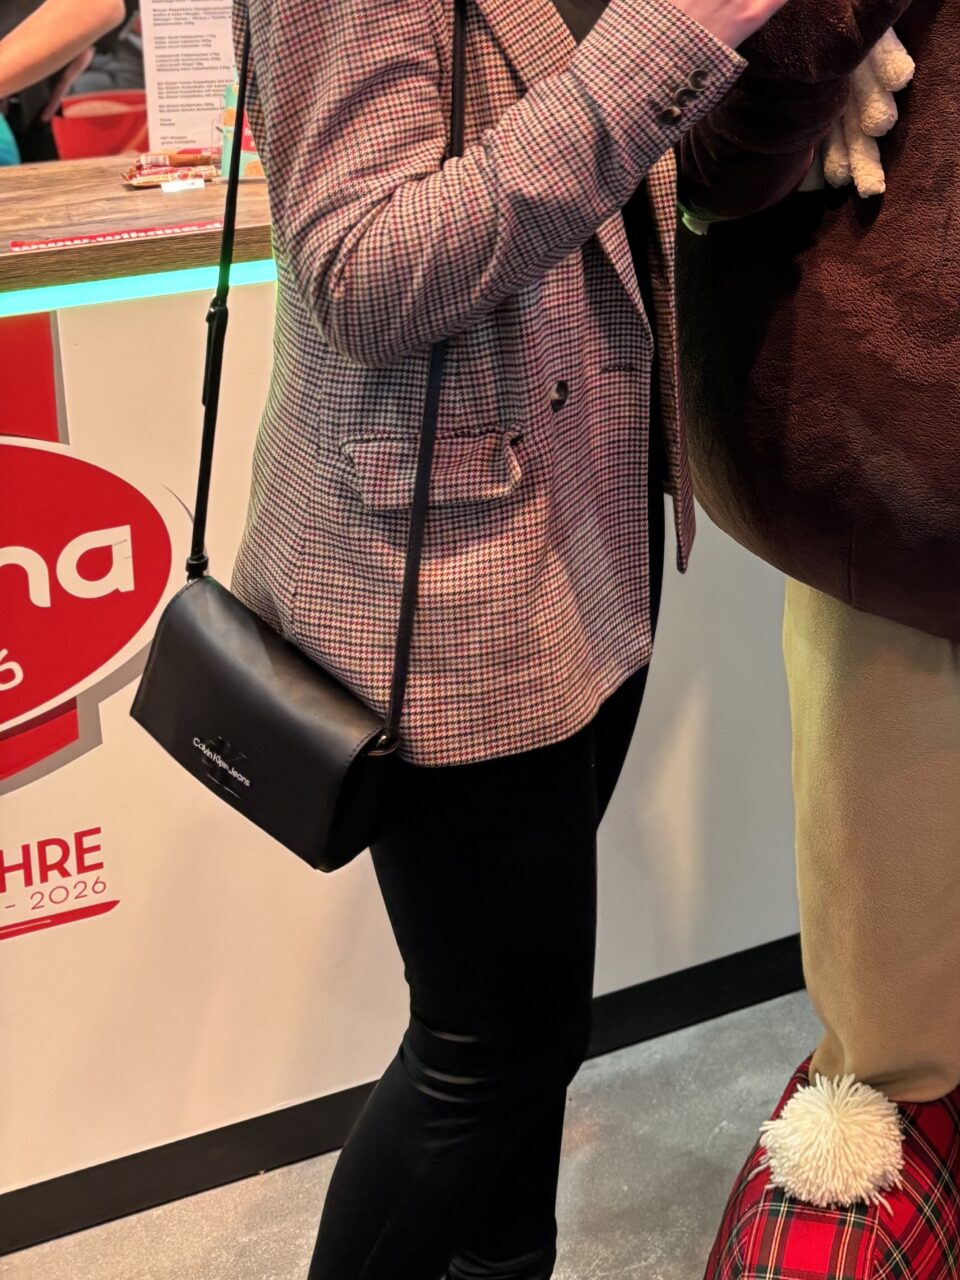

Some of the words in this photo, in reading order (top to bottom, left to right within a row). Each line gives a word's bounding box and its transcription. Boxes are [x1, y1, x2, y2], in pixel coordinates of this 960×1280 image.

[11, 223, 223, 251] www.wikana.d
[0, 524, 135, 608] na
[0, 648, 24, 691] 6
[193, 737, 213, 760] Calvin
[212, 753, 229, 771] Klein
[228, 766, 251, 787] Jeans
[0, 826, 104, 893] HRE
[30, 875, 107, 910] 2026
